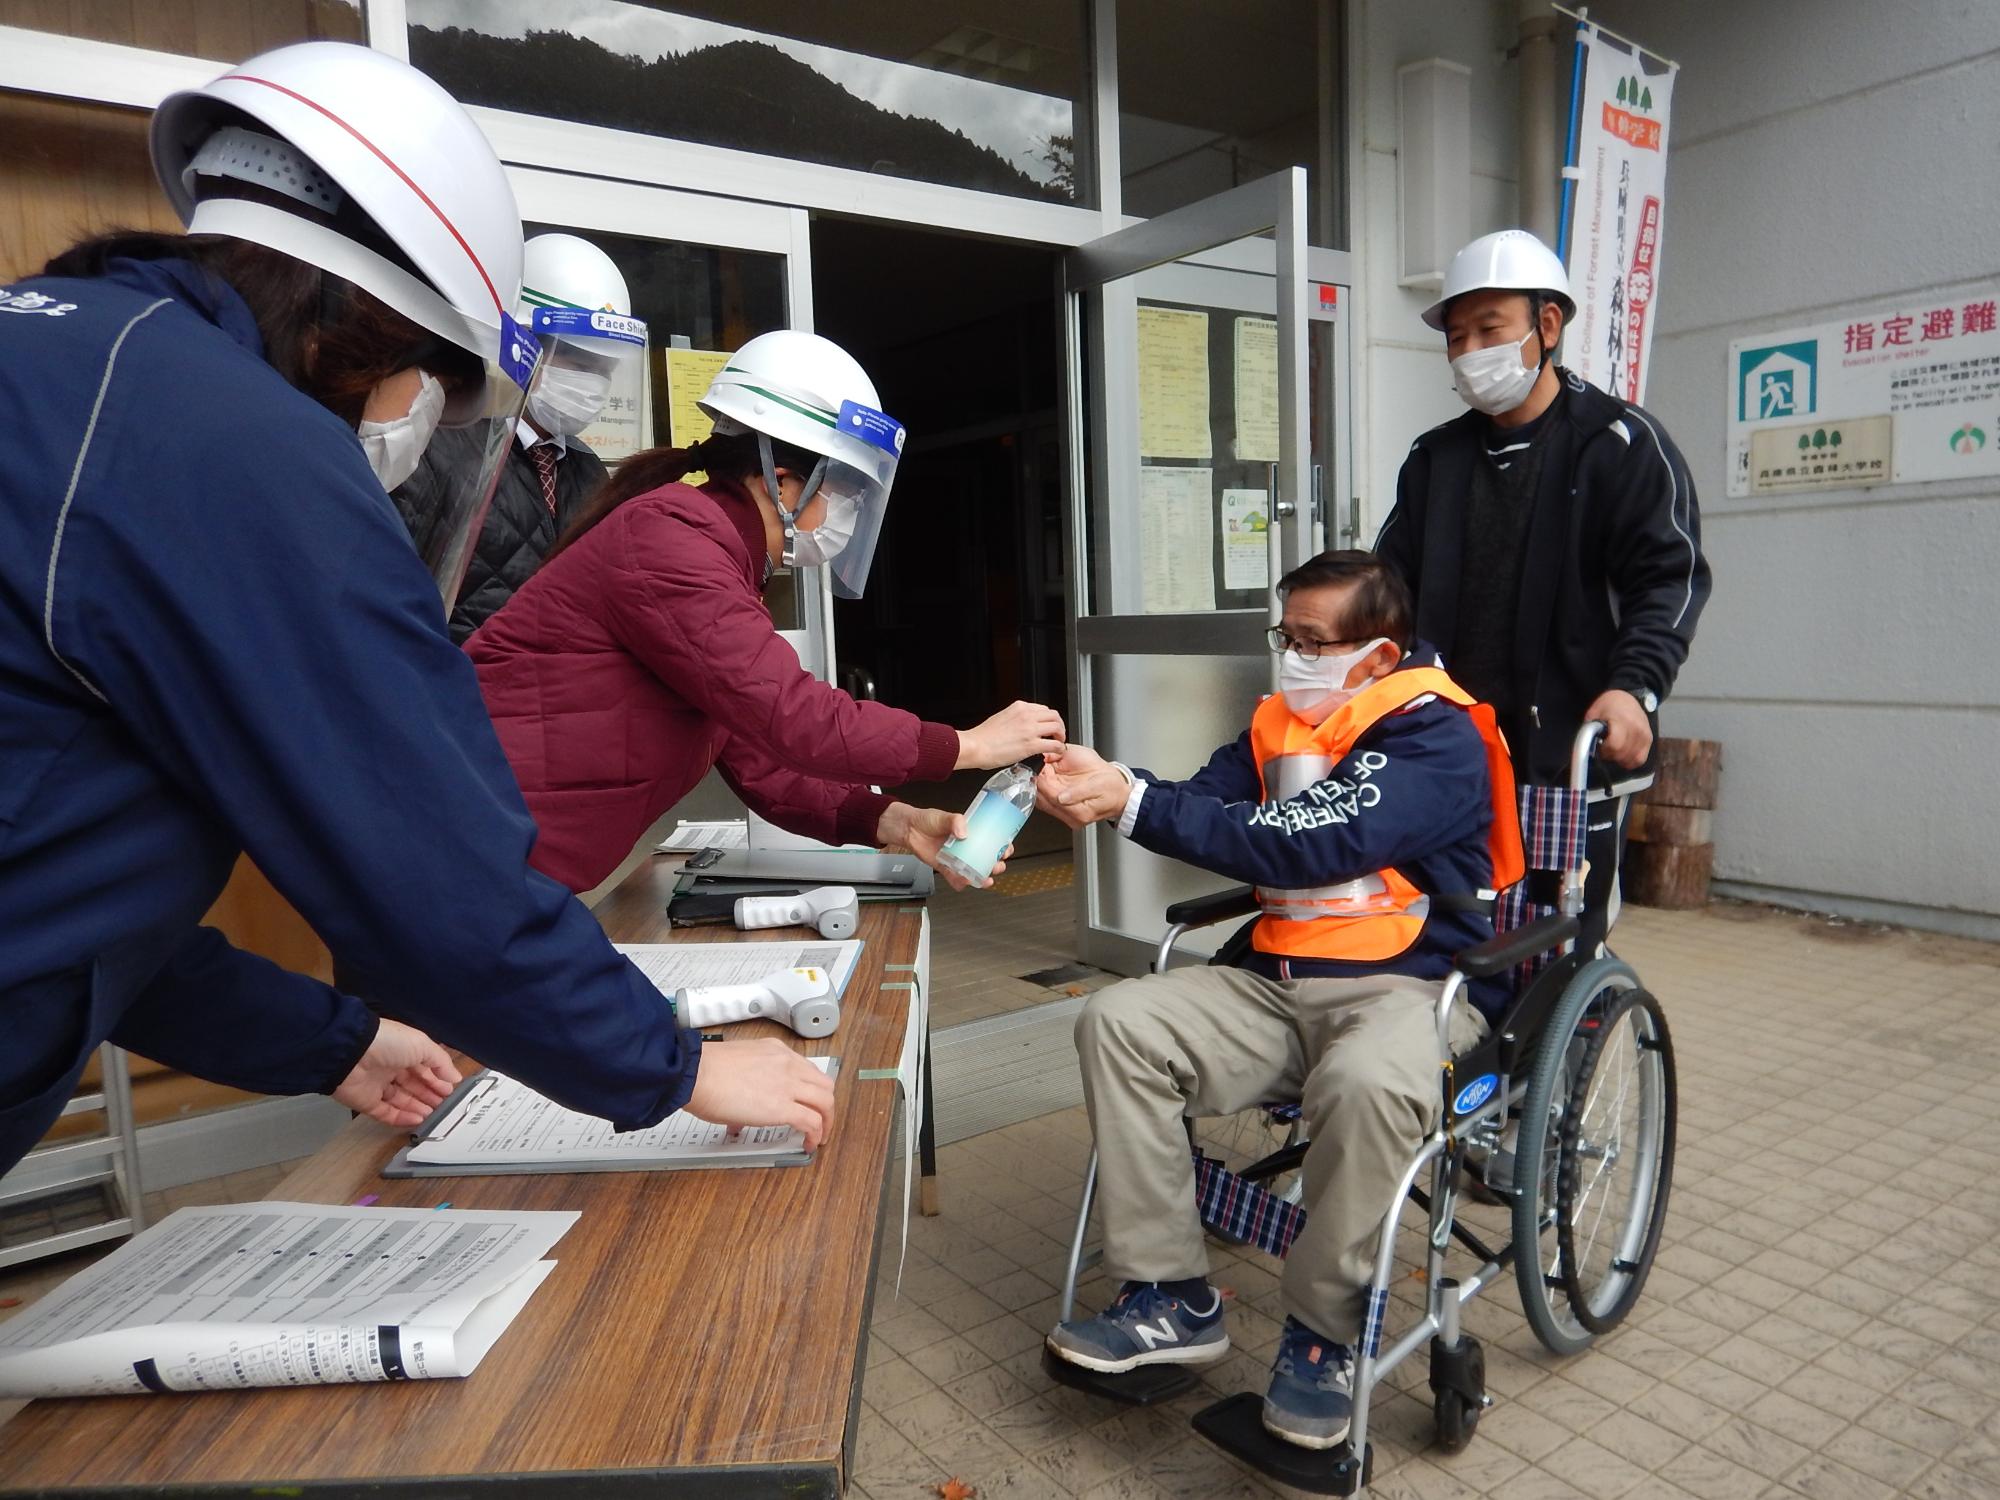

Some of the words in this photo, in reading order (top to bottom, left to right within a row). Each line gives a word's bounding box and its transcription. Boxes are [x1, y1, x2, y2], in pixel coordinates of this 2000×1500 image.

[1590, 147, 1605, 235] Management
[1587, 239, 1600, 281] Forest
[1586, 284, 1595, 300] of
[598, 317, 625, 331] Face
[1581, 304, 1596, 353] College
[1844, 301, 1997, 354] 指定避難
[1354, 751, 1388, 780] OF
